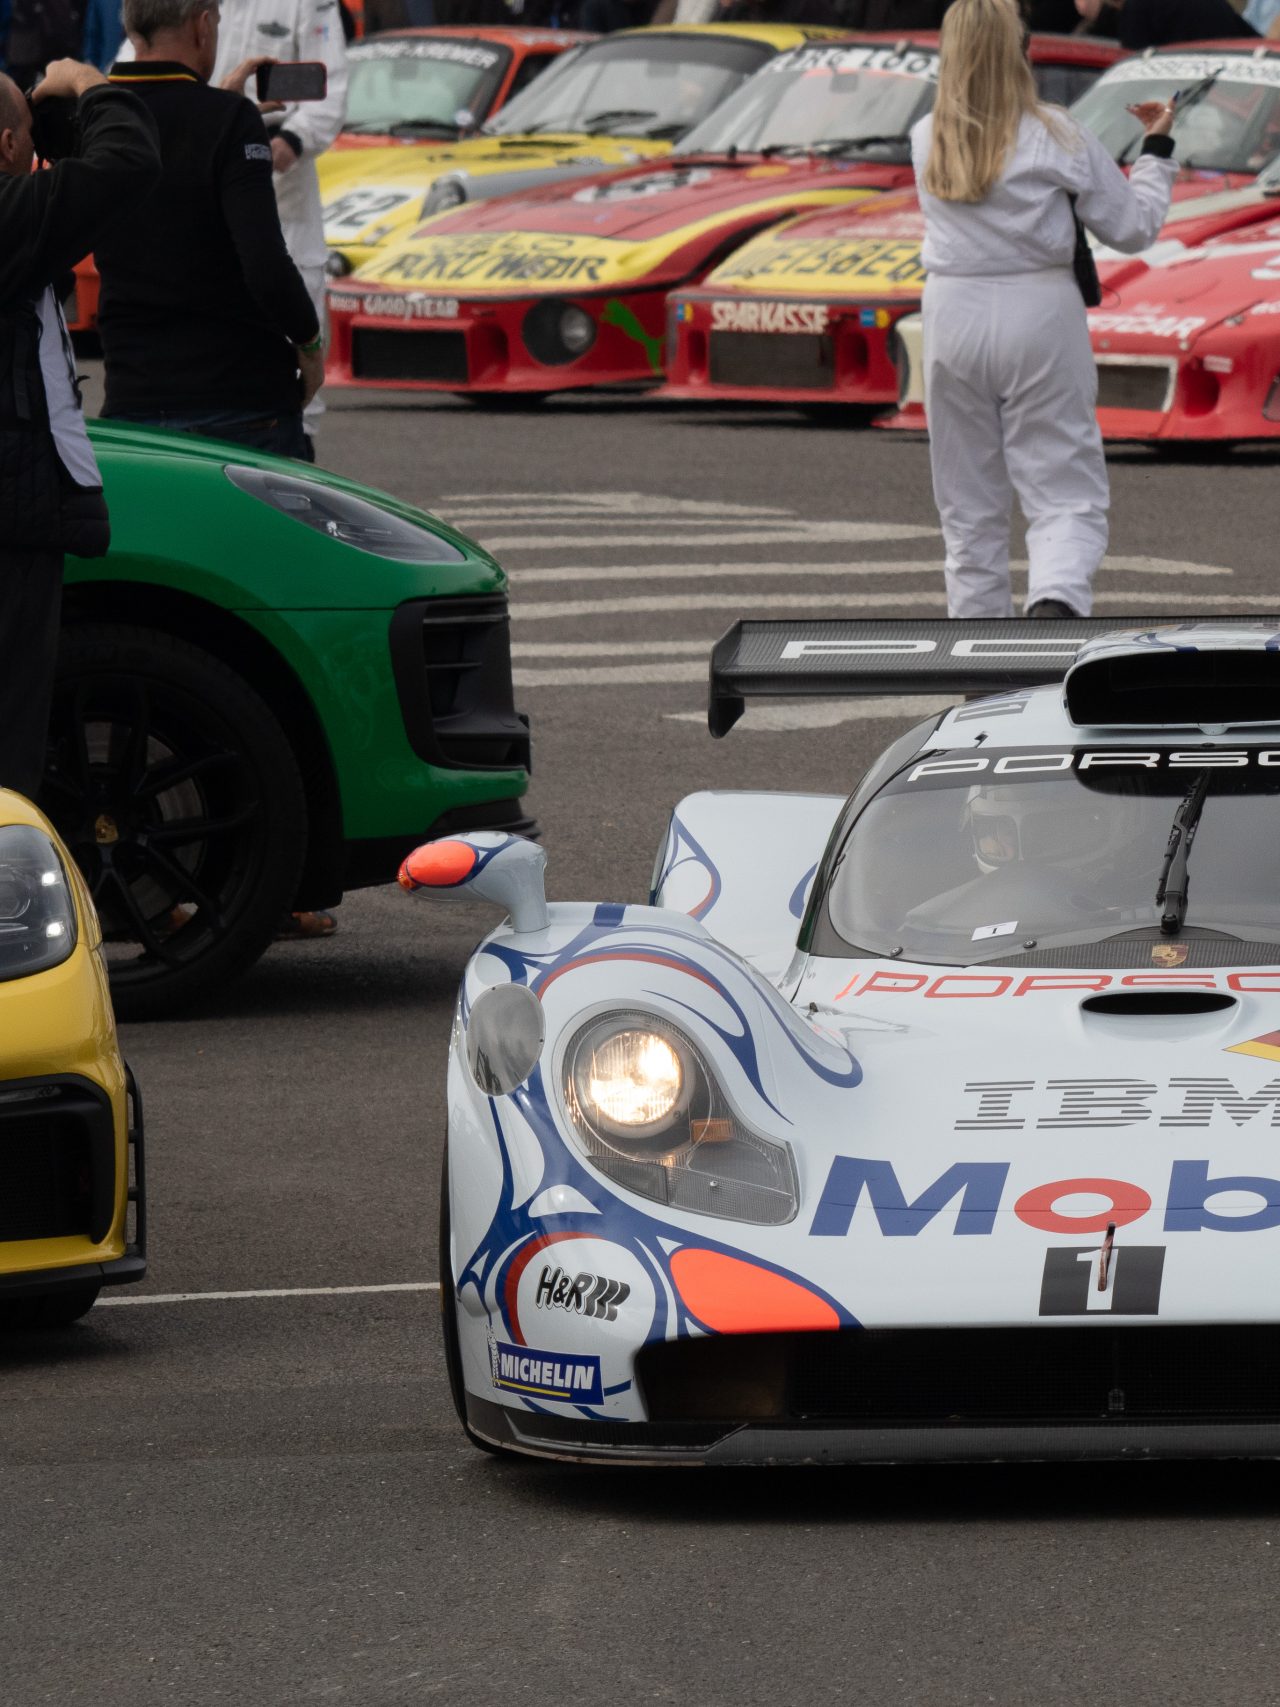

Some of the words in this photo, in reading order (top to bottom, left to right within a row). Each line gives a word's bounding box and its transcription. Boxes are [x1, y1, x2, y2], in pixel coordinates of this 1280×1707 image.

[361, 293, 459, 319] GOODYEAR
[710, 301, 828, 334] SPARKASSE
[536, 1265, 606, 1317] H&R
[1075, 1250, 1122, 1314] 1
[500, 1352, 595, 1391] MICHELIN
